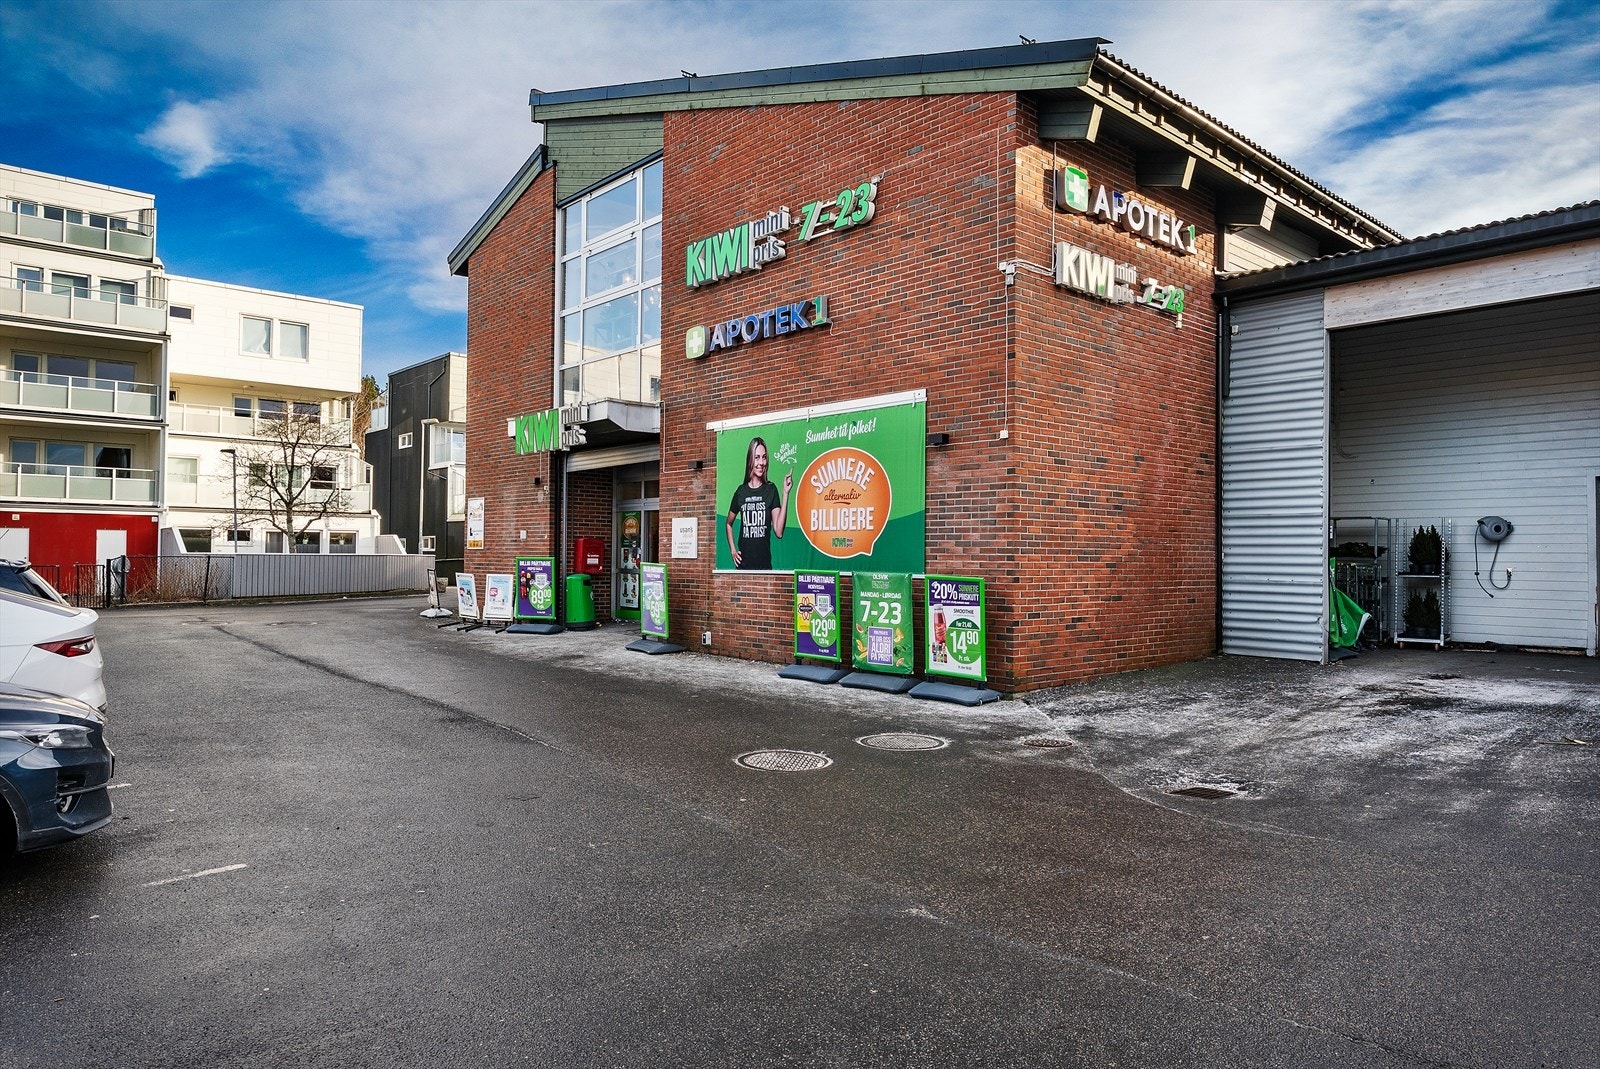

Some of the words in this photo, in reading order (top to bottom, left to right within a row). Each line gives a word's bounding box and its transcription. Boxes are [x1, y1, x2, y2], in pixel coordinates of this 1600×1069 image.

[753, 208, 786, 238] mini
[798, 182, 871, 241] 7-23
[1094, 185, 1184, 249] APOTEK
[686, 221, 750, 287] KIWI
[753, 237, 780, 266] pris
[1061, 242, 1115, 299] KIWI
[1115, 263, 1137, 284] mini
[1142, 277, 1185, 313] 7-23
[709, 301, 808, 351] APOTEK
[561, 404, 582, 425] mini
[515, 408, 559, 455] KIWI
[561, 427, 581, 447] pris
[806, 426, 838, 444] Sunnhet
[839, 422, 848, 438] til
[848, 417, 877, 440] folket!
[811, 457, 875, 494] SUNNERE
[756, 501, 766, 511] OSS
[824, 488, 861, 501] alternativ
[743, 511, 766, 526] ALDRI
[811, 507, 874, 531] BILLIGERE
[931, 583, 958, 600] -20%
[860, 600, 902, 625] 7-23
[871, 642, 891, 654] ALDRI
